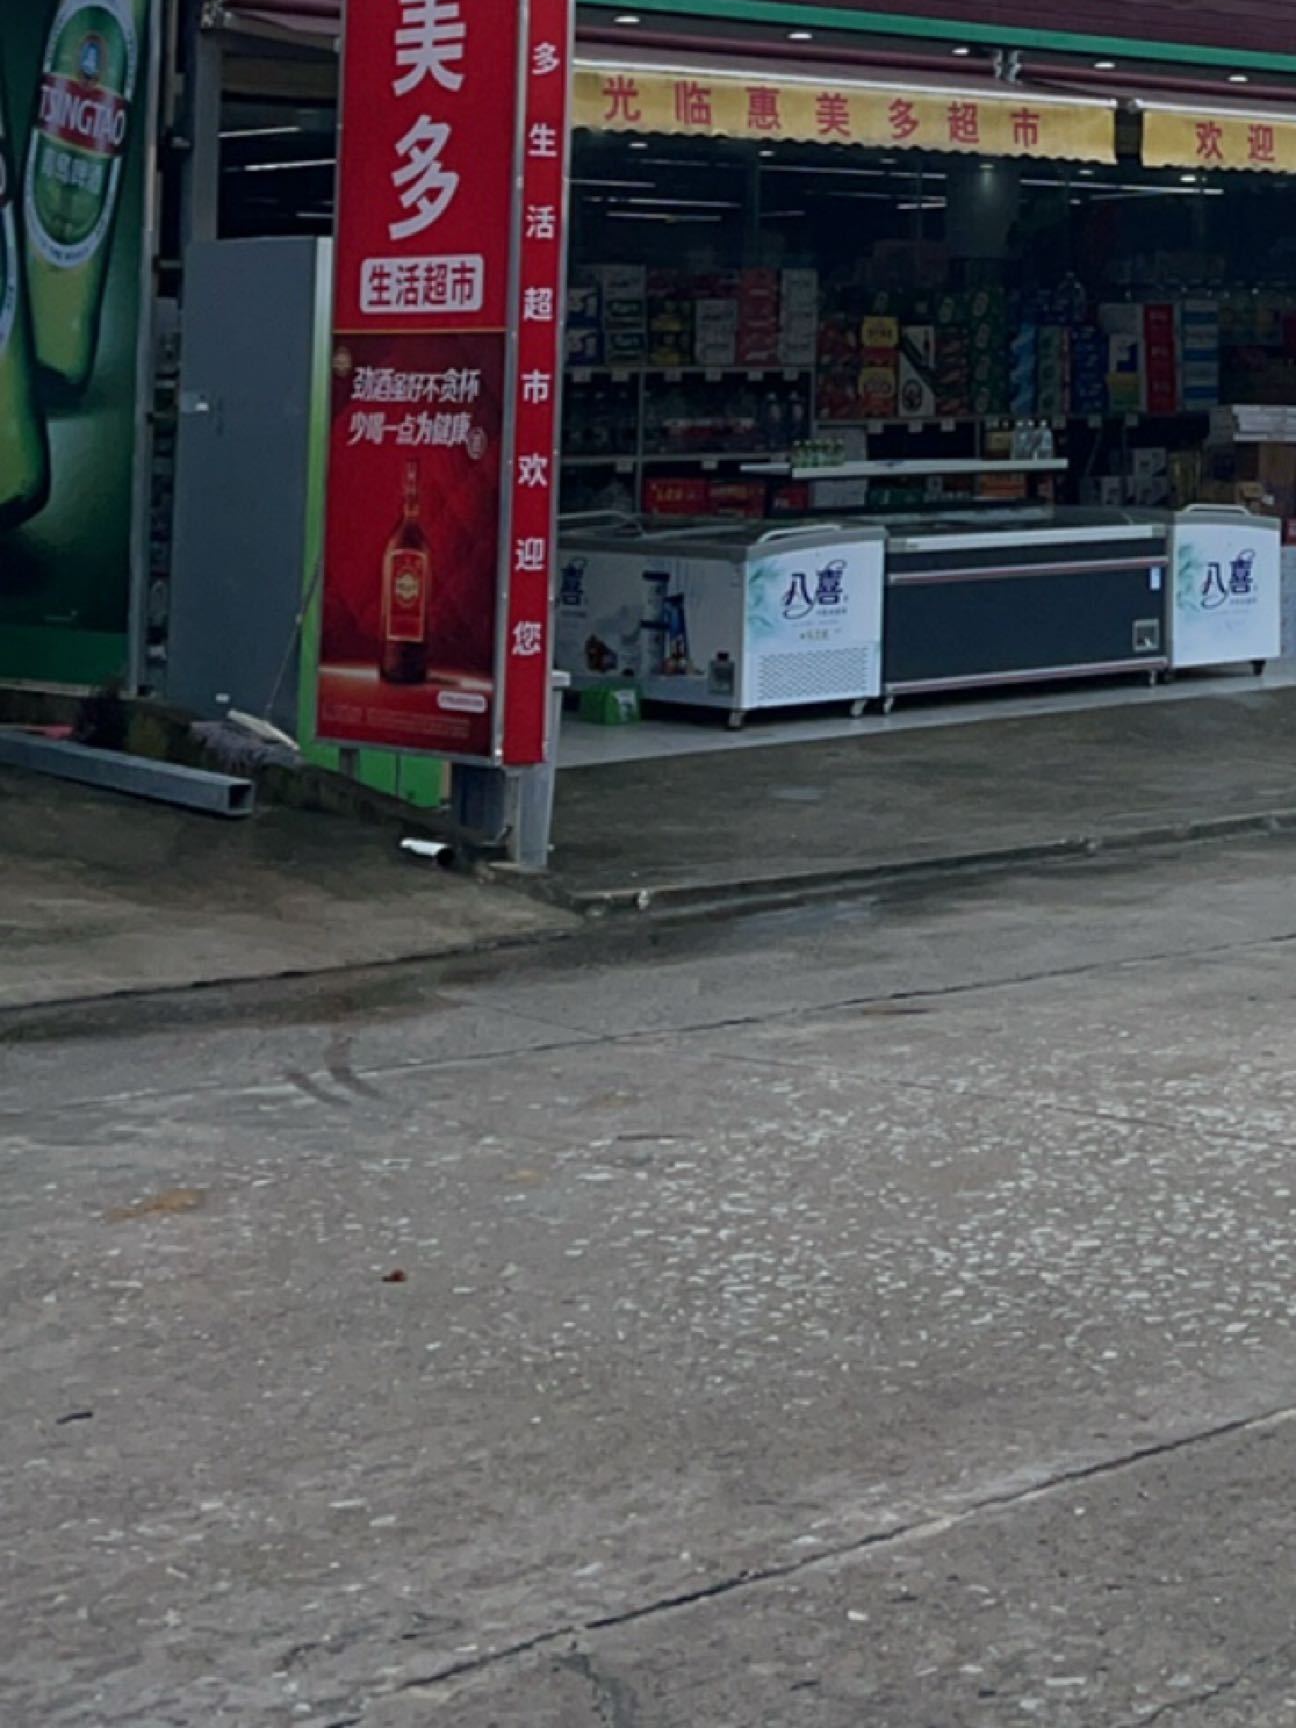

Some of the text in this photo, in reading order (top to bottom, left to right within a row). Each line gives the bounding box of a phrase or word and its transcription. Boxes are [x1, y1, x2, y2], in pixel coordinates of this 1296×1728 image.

[38, 84, 126, 147] TSINGTAO
[602, 76, 1041, 148] 光临惠美多超市
[367, 258, 477, 307] 生活超市
[783, 561, 848, 617] 八喜
[1201, 550, 1254, 609] 八喜
